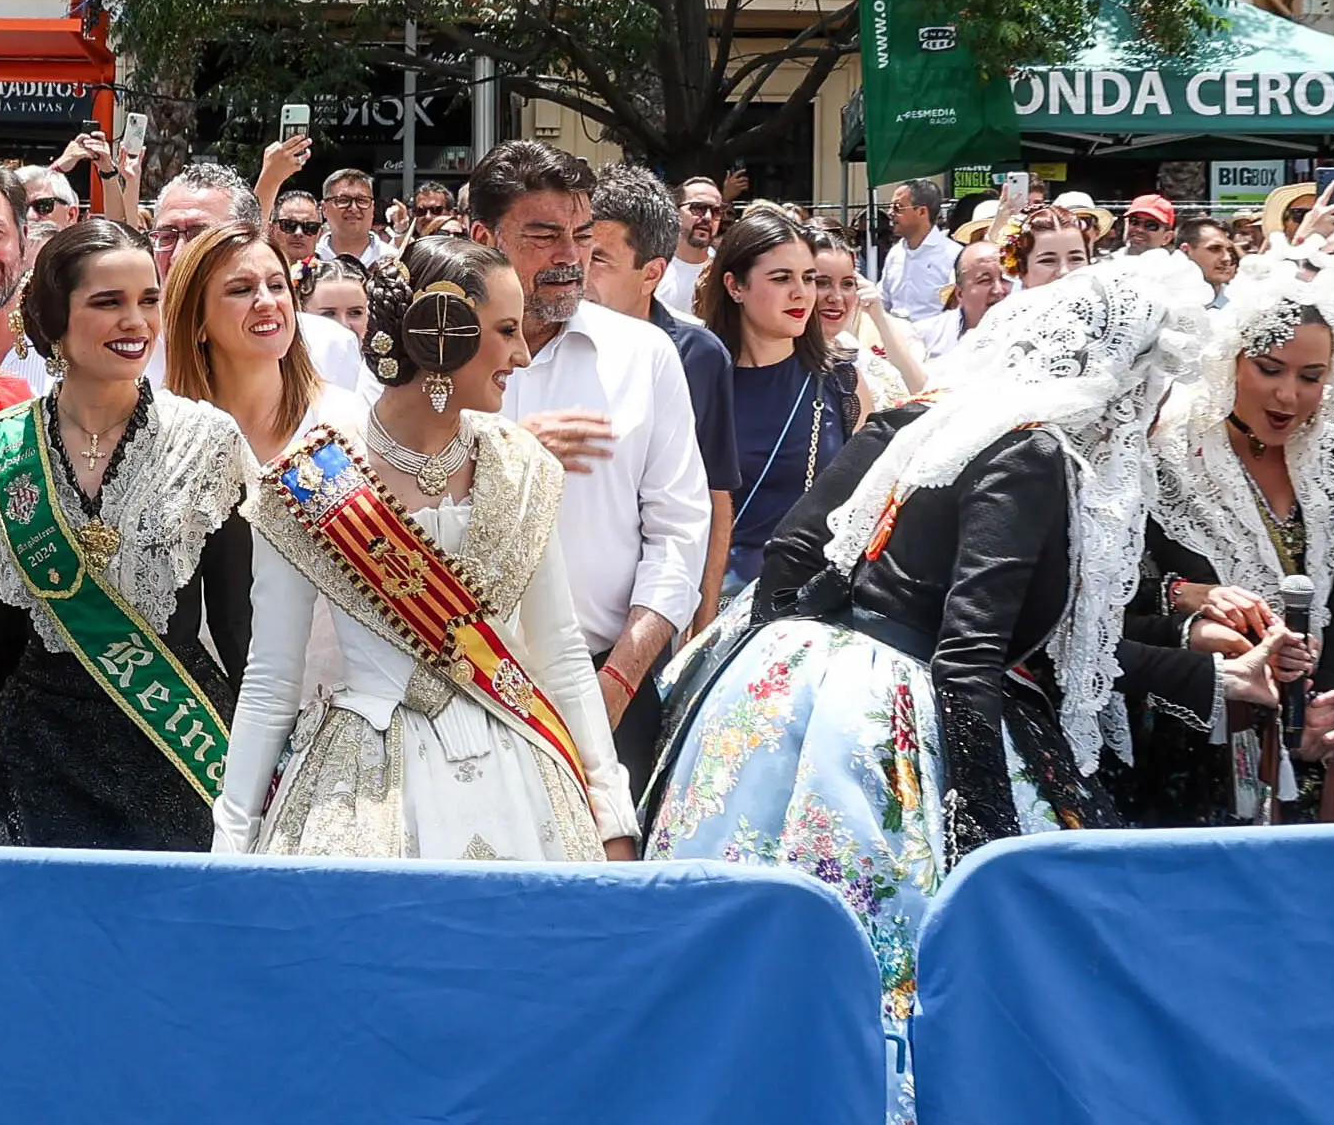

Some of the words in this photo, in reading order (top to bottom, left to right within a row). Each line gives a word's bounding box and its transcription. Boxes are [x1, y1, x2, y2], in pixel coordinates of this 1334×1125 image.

[1011, 70, 1172, 116] ONDA
[929, 117, 957, 125] RADIO
[954, 171, 992, 187] SINGLE
[28, 542, 58, 567] 2024
